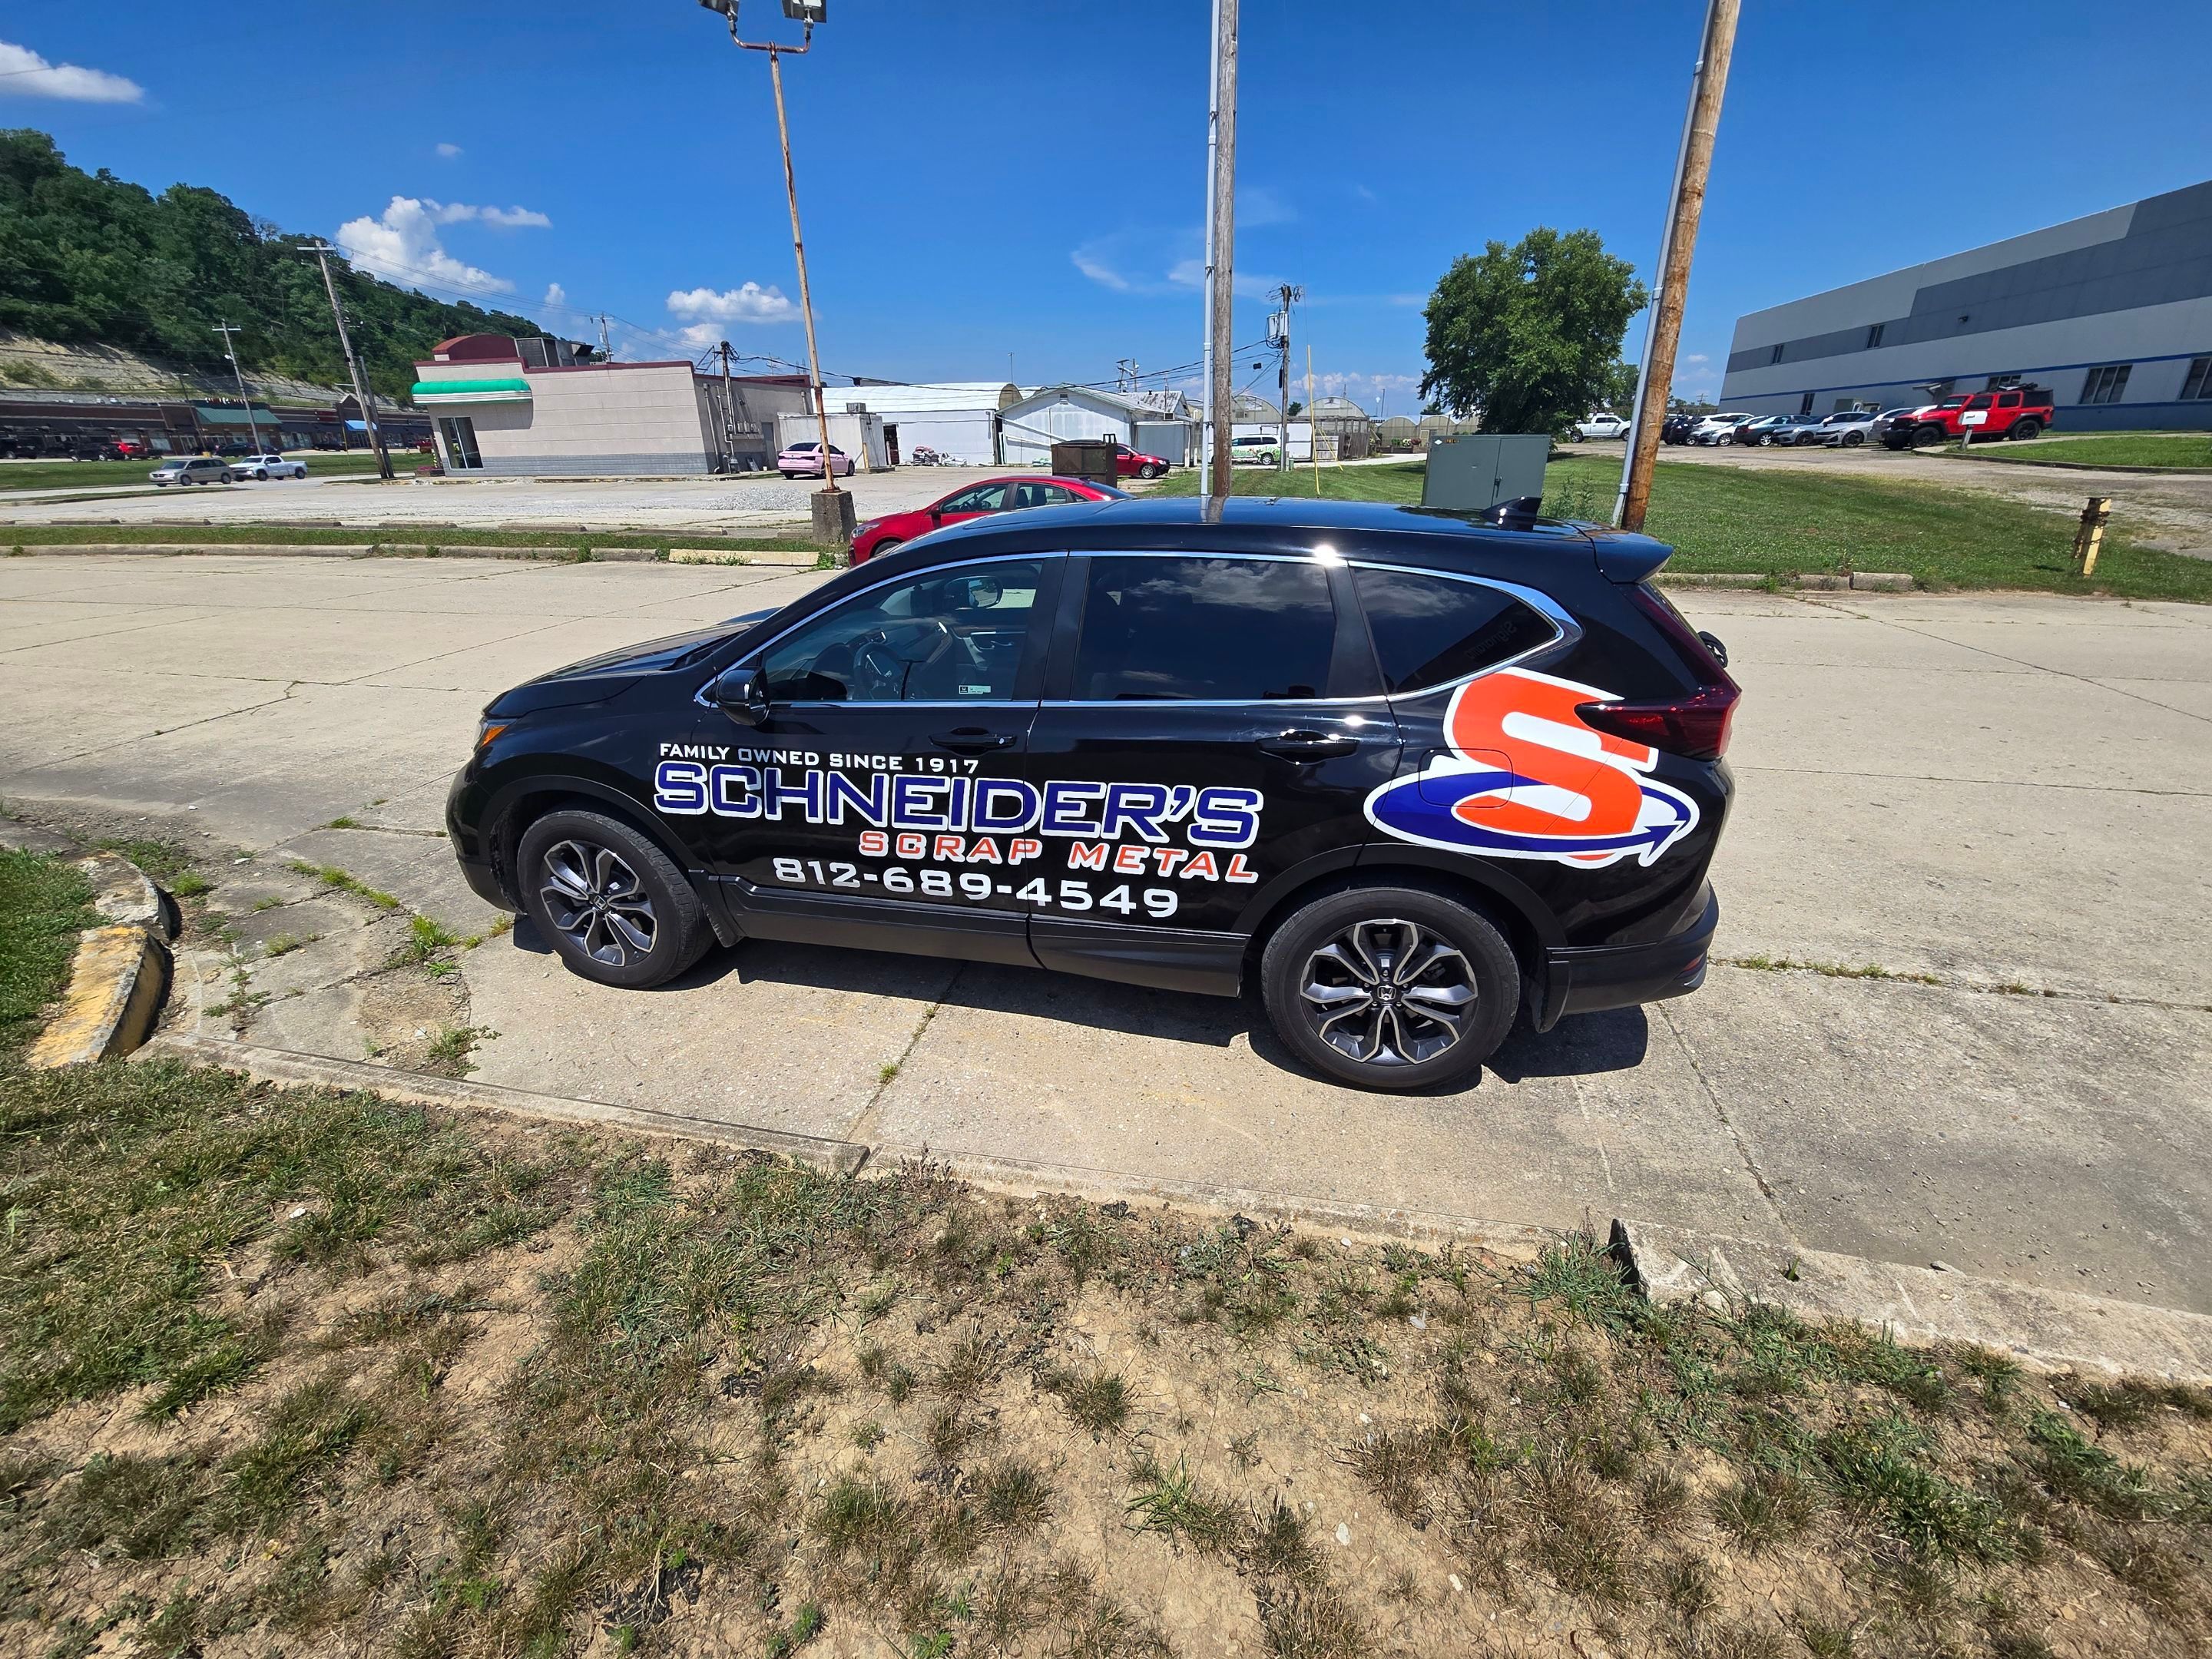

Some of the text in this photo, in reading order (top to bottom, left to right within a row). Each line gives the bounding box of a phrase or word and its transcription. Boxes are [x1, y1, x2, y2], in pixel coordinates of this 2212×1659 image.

[660, 743, 979, 774] FAMILY OWNED SINCE 1917
[654, 761, 1263, 849] SCHNEIDER'S
[859, 831, 1258, 883] SCRAP METAL
[775, 858, 1178, 918] 812-689-4549
